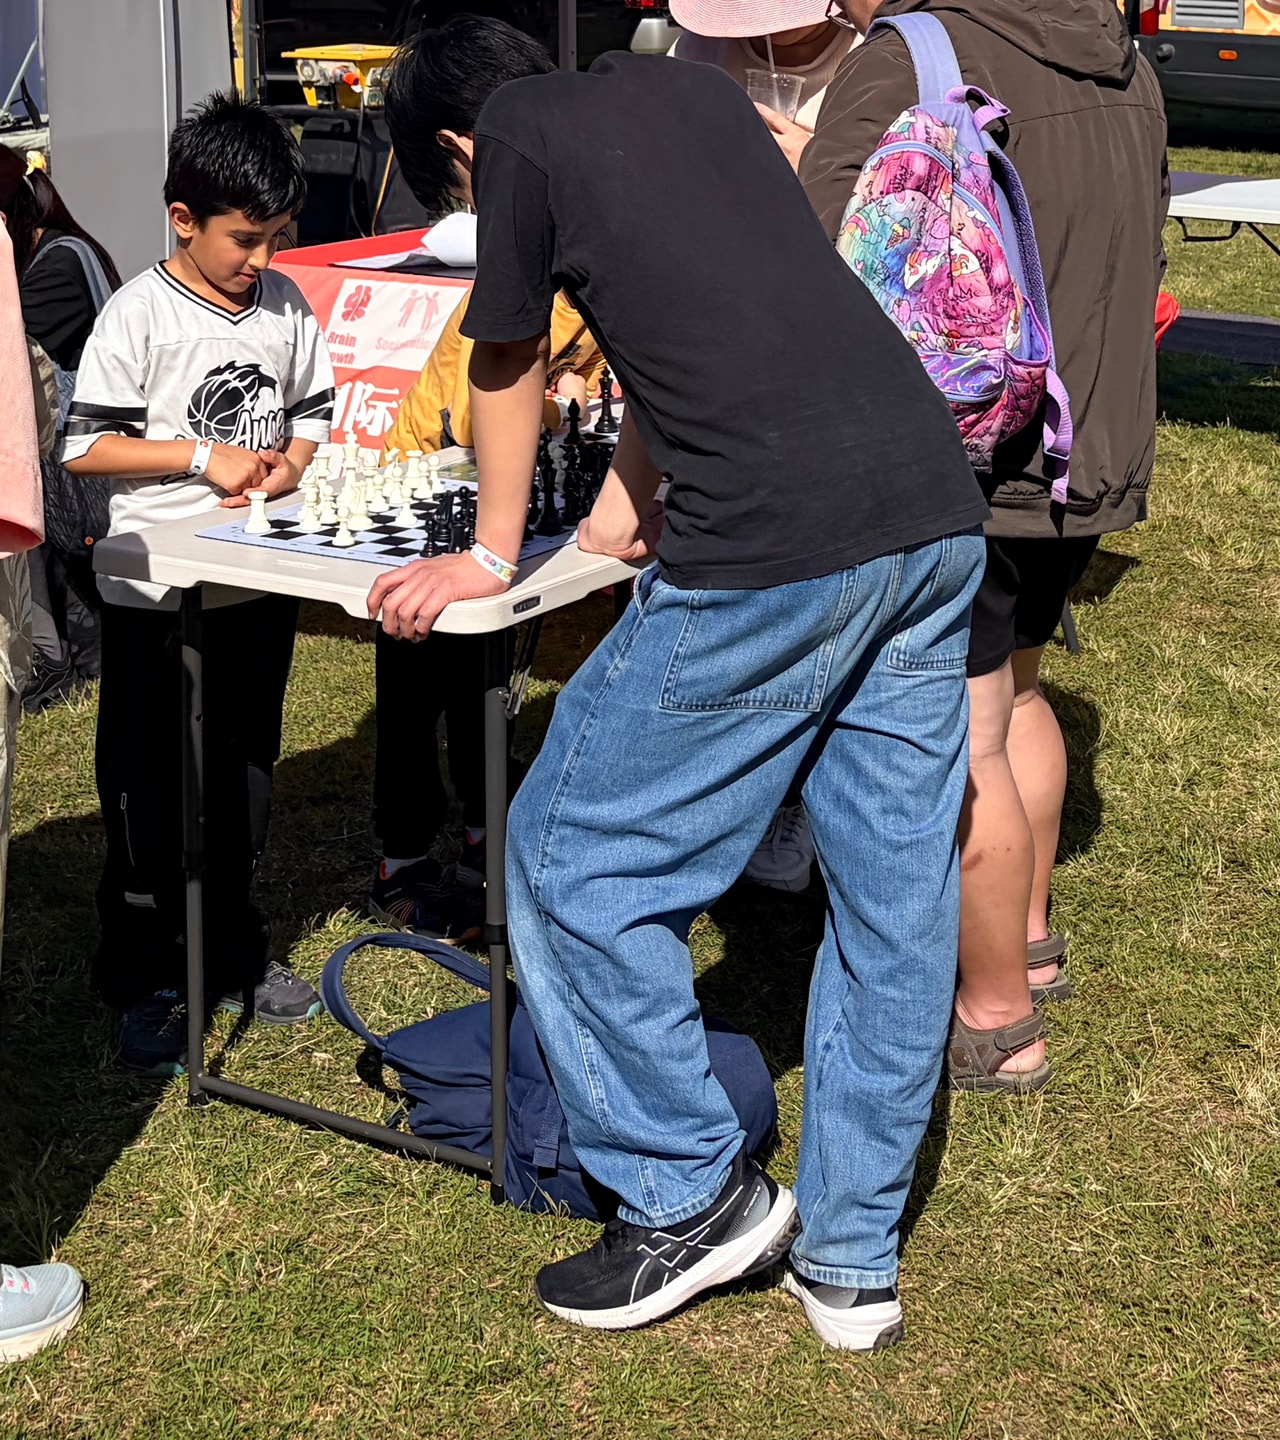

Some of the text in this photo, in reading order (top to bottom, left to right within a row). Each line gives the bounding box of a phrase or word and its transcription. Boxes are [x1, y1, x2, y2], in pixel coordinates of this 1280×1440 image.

[327, 330, 357, 348] Brain
[330, 352, 356, 366] owth
[330, 380, 403, 437] 际
